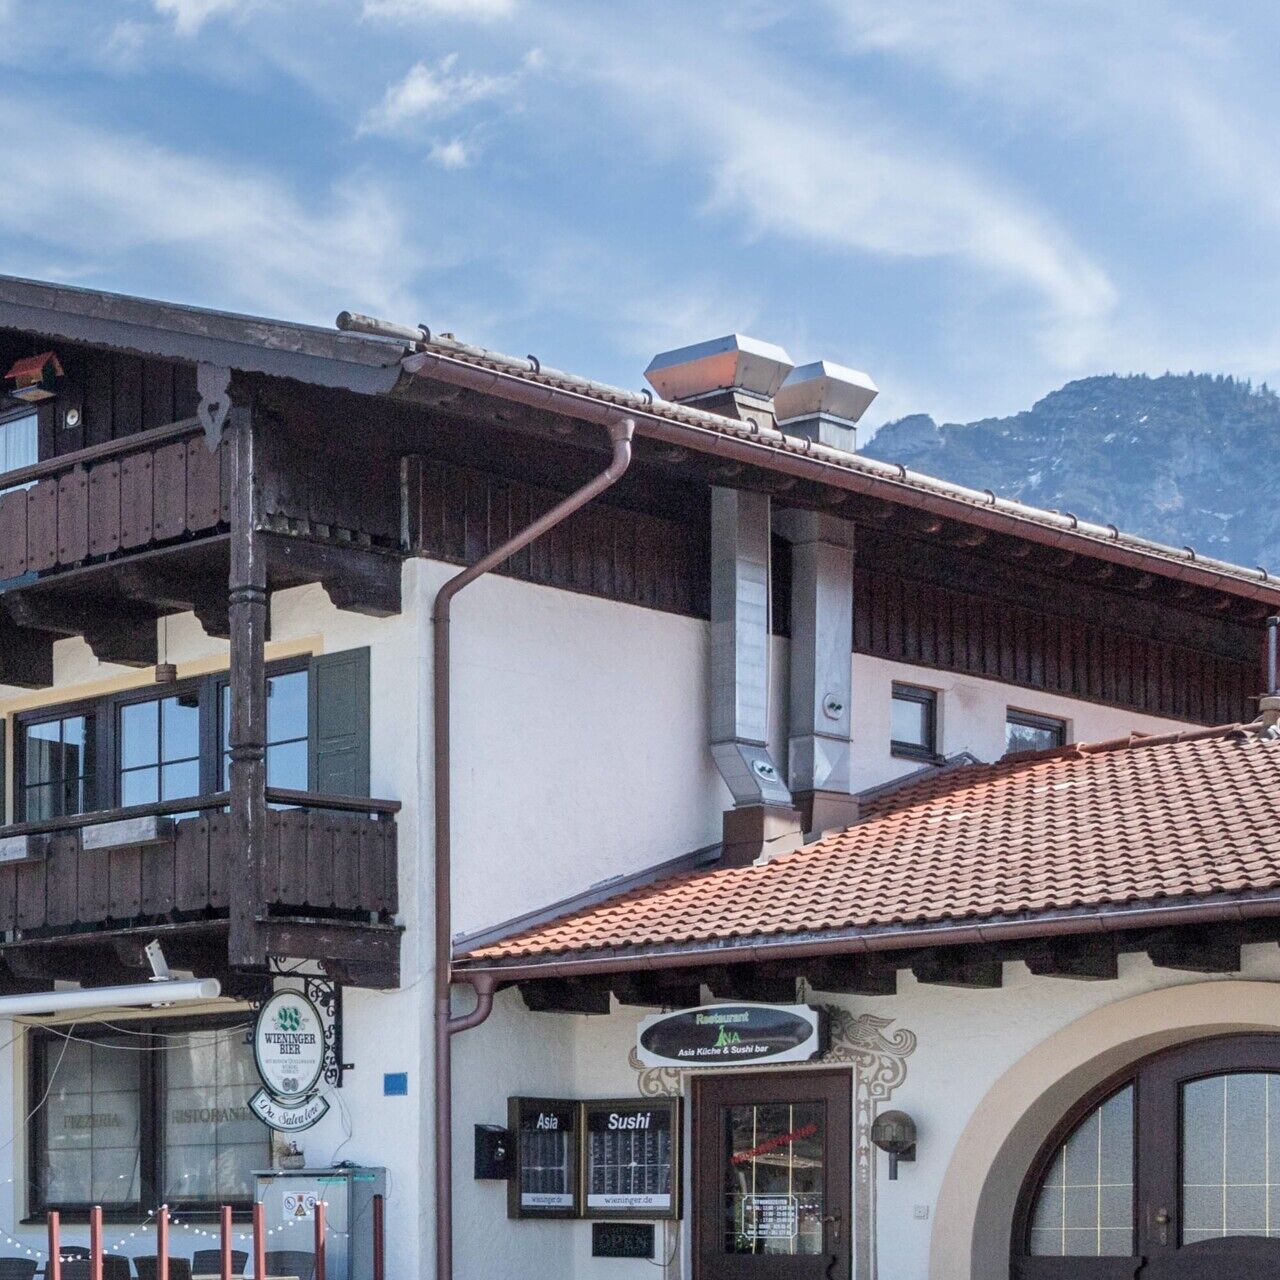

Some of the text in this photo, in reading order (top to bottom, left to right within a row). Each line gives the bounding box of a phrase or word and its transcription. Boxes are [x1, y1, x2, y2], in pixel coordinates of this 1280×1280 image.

[696, 1011, 749, 1025] Restaurant
[265, 1033, 316, 1044] WIENINGER
[280, 1044, 301, 1054] BIER
[678, 1045, 769, 1057] Asia Küche & Sushi bar
[258, 1099, 319, 1126] Da Salvatore
[536, 1113, 558, 1130] Asia
[608, 1113, 651, 1130] Sushi
[605, 1196, 653, 1206] wieninger.de
